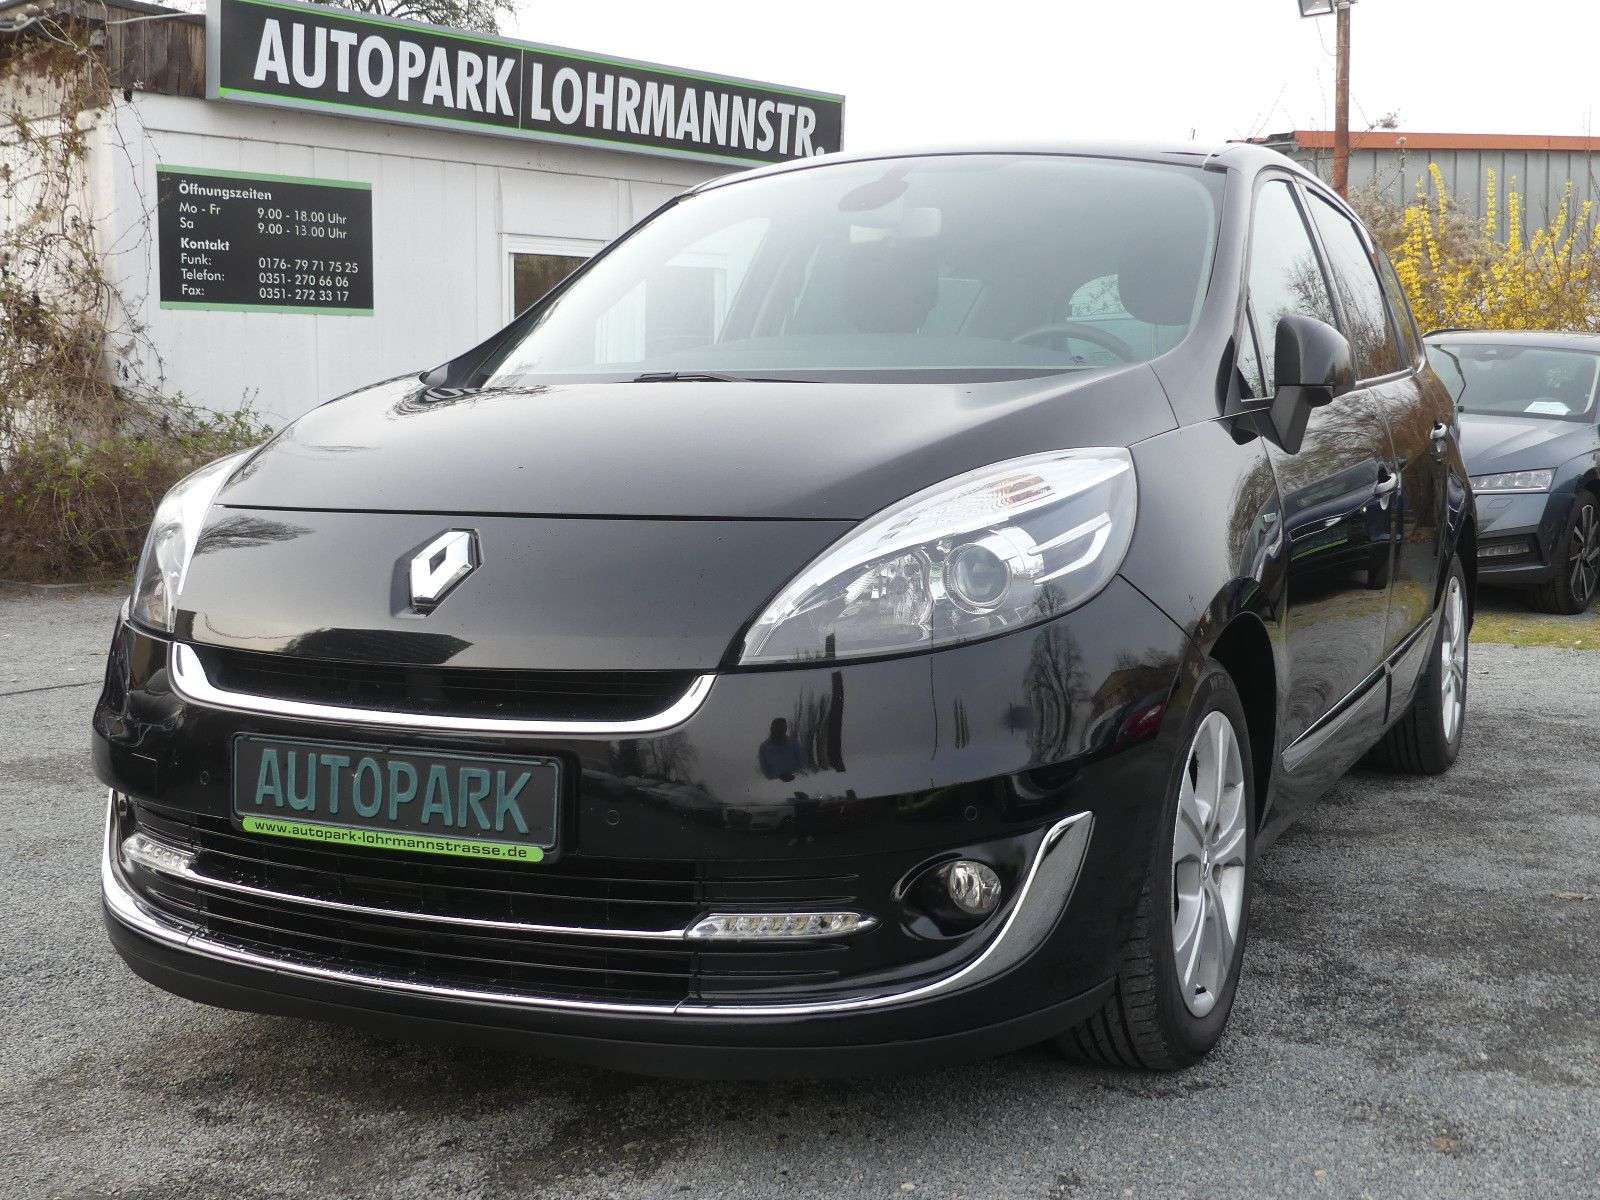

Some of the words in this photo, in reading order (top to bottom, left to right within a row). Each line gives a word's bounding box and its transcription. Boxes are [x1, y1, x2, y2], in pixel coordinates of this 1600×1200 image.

[253, 18, 515, 117] AUTOPARK
[531, 62, 825, 157] LOHRMANNSTR.
[179, 180, 272, 201] Öffnungszeiten
[179, 202, 198, 214] Mo
[209, 203, 221, 215] Fr
[257, 207, 282, 220] 9.00
[294, 210, 325, 223] 18.00
[327, 212, 347, 225] Uhr
[179, 217, 194, 229] Sa
[257, 222, 283, 235] 9.00
[327, 227, 347, 239] Uhr
[180, 237, 230, 251] Kontakt
[181, 252, 212, 265] Funk:
[295, 259, 309, 271] 79
[312, 260, 324, 272] 71
[328, 261, 342, 273] 75
[345, 262, 359, 274] 25
[180, 268, 225, 282] Telefon:
[295, 274, 316, 286] 270
[319, 275, 333, 287] 66
[336, 276, 349, 288] 06
[181, 283, 205, 296] Fax:
[295, 289, 316, 301] 272
[319, 290, 333, 302] 33
[337, 291, 349, 302] 17
[255, 749, 532, 835] AUTOPARK
[254, 820, 527, 859] www.autopark-lohrmannstrasse.de
